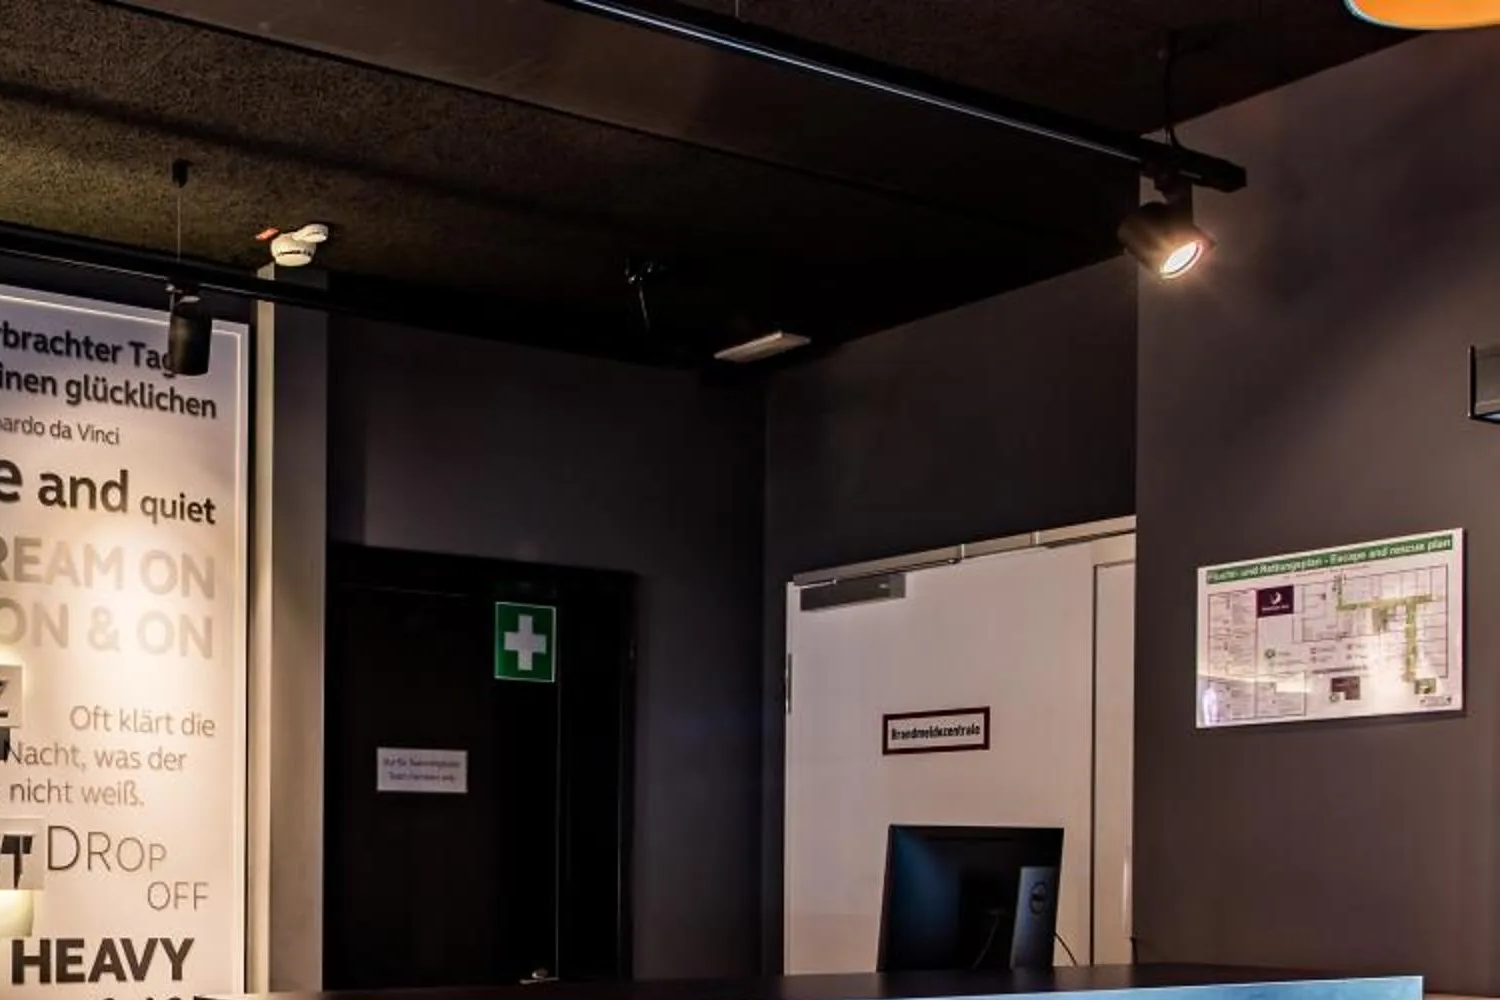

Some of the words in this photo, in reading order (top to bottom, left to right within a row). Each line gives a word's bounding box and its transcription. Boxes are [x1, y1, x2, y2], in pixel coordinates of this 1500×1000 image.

[65, 374, 217, 420] glücklichen
[49, 415, 73, 440] da
[77, 423, 121, 447] Vinci
[37, 469, 129, 514] and
[140, 491, 217, 528] quiet
[140, 547, 216, 600] ON
[136, 608, 214, 660] ON
[70, 705, 112, 732] Oft
[118, 708, 175, 735] klärt
[180, 712, 216, 738] die
[3, 741, 86, 769] Nacht,
[95, 750, 142, 771] was
[148, 748, 188, 772] der
[9, 778, 74, 805] nicht
[81, 782, 146, 808] weiß.
[147, 880, 209, 911] OFF
[10, 937, 194, 986] HEAVY
